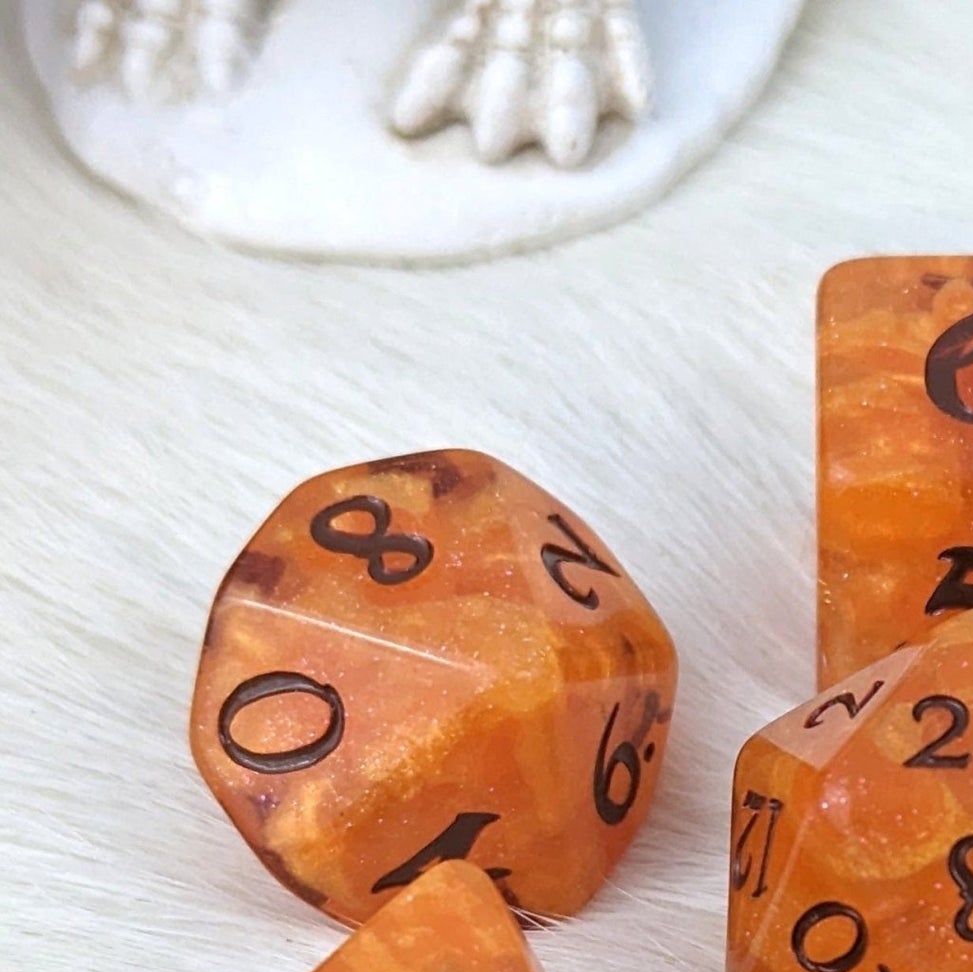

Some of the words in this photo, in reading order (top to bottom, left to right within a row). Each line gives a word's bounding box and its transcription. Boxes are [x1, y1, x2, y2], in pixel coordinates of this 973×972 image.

[309, 494, 434, 586] 8
[540, 513, 621, 610] 2
[218, 670, 346, 775] 0
